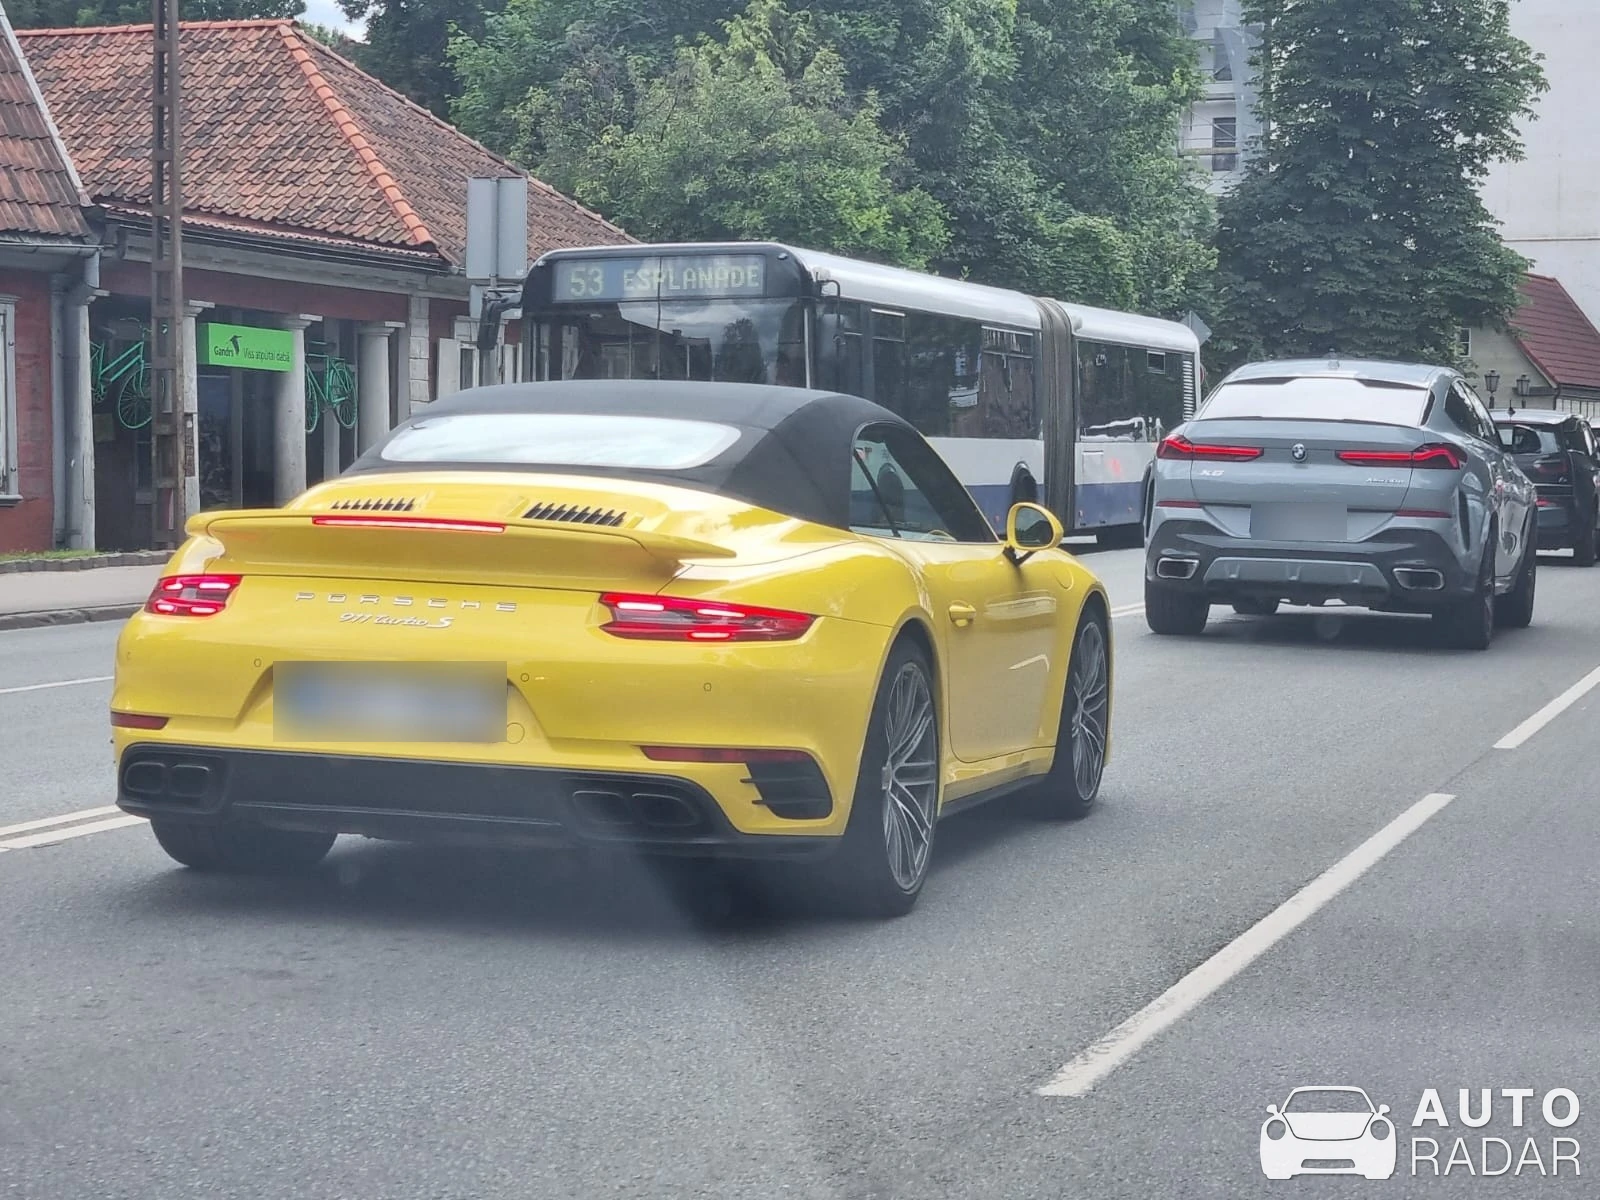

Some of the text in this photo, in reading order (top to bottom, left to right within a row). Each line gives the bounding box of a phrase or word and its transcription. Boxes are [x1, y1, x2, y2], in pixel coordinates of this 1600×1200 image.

[570, 265, 760, 296] 53 ESPLANADE
[295, 592, 517, 612] PORSCHE
[339, 612, 373, 624] 911
[426, 616, 456, 628] S
